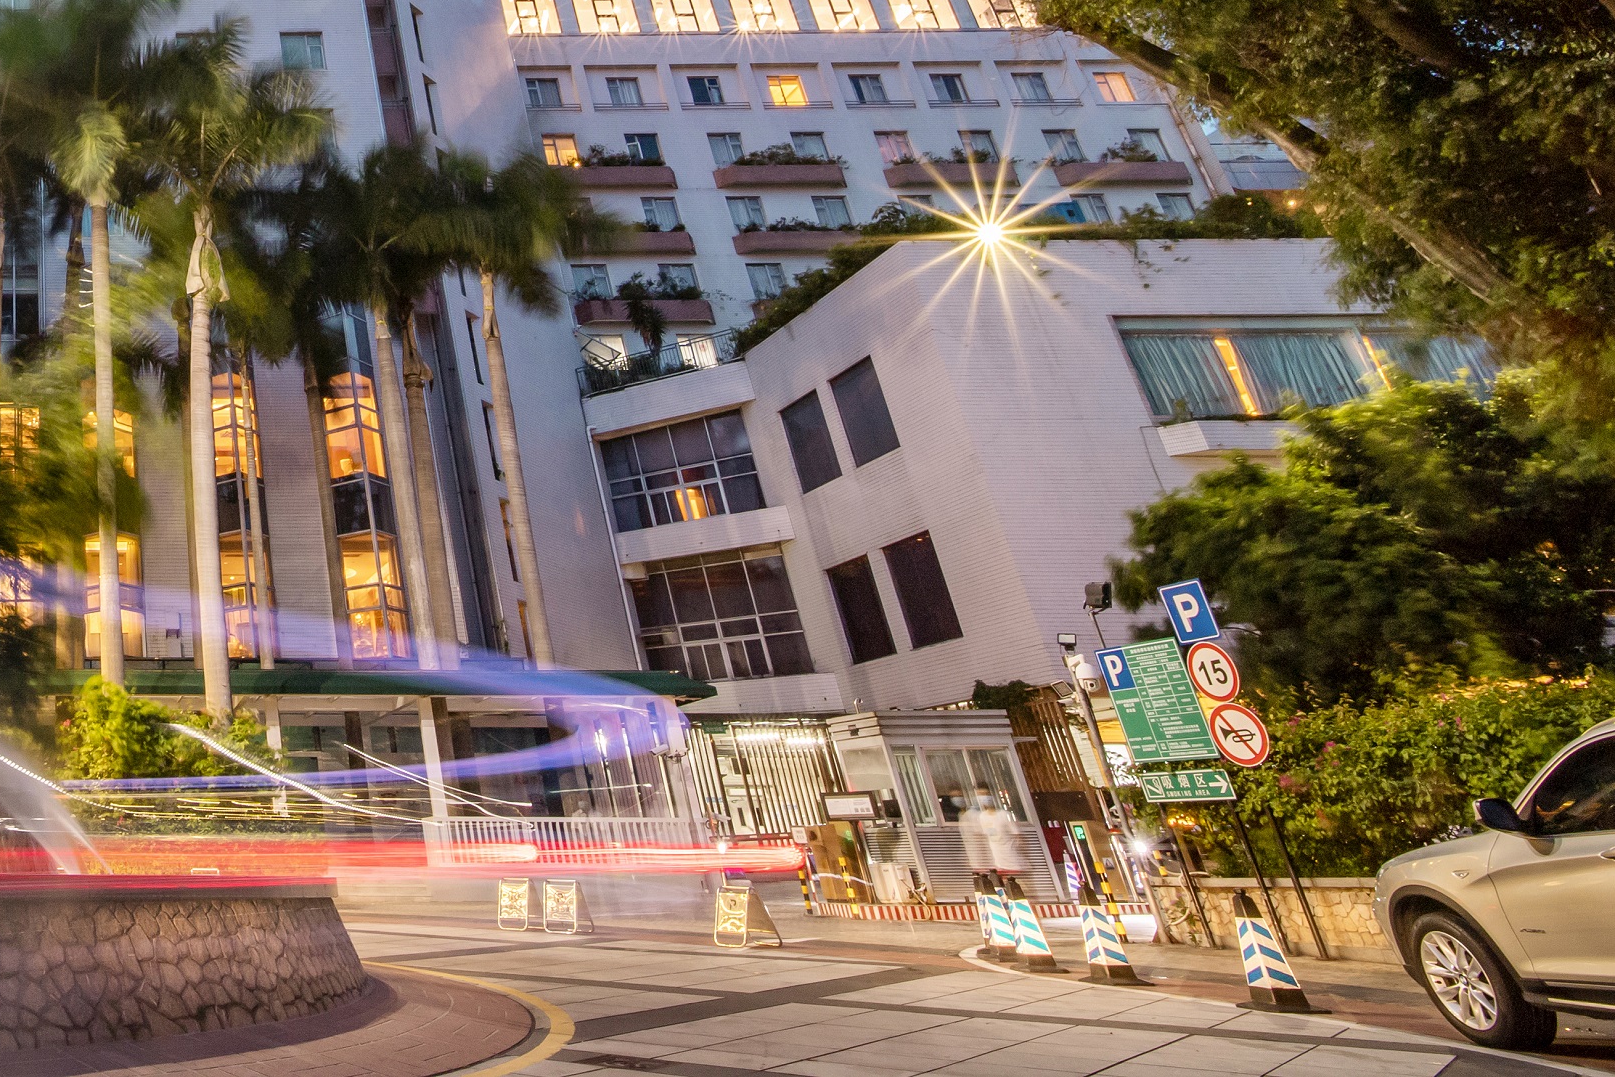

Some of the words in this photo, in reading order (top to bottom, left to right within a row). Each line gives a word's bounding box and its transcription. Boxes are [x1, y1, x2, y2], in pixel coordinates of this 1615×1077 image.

[1173, 593, 1200, 633] P
[1103, 654, 1123, 687] P
[1198, 659, 1229, 686] 15
[1160, 773, 1208, 789] 吸烟区
[1166, 790, 1193, 798] SMOKING
[1195, 789, 1211, 797] AREA
